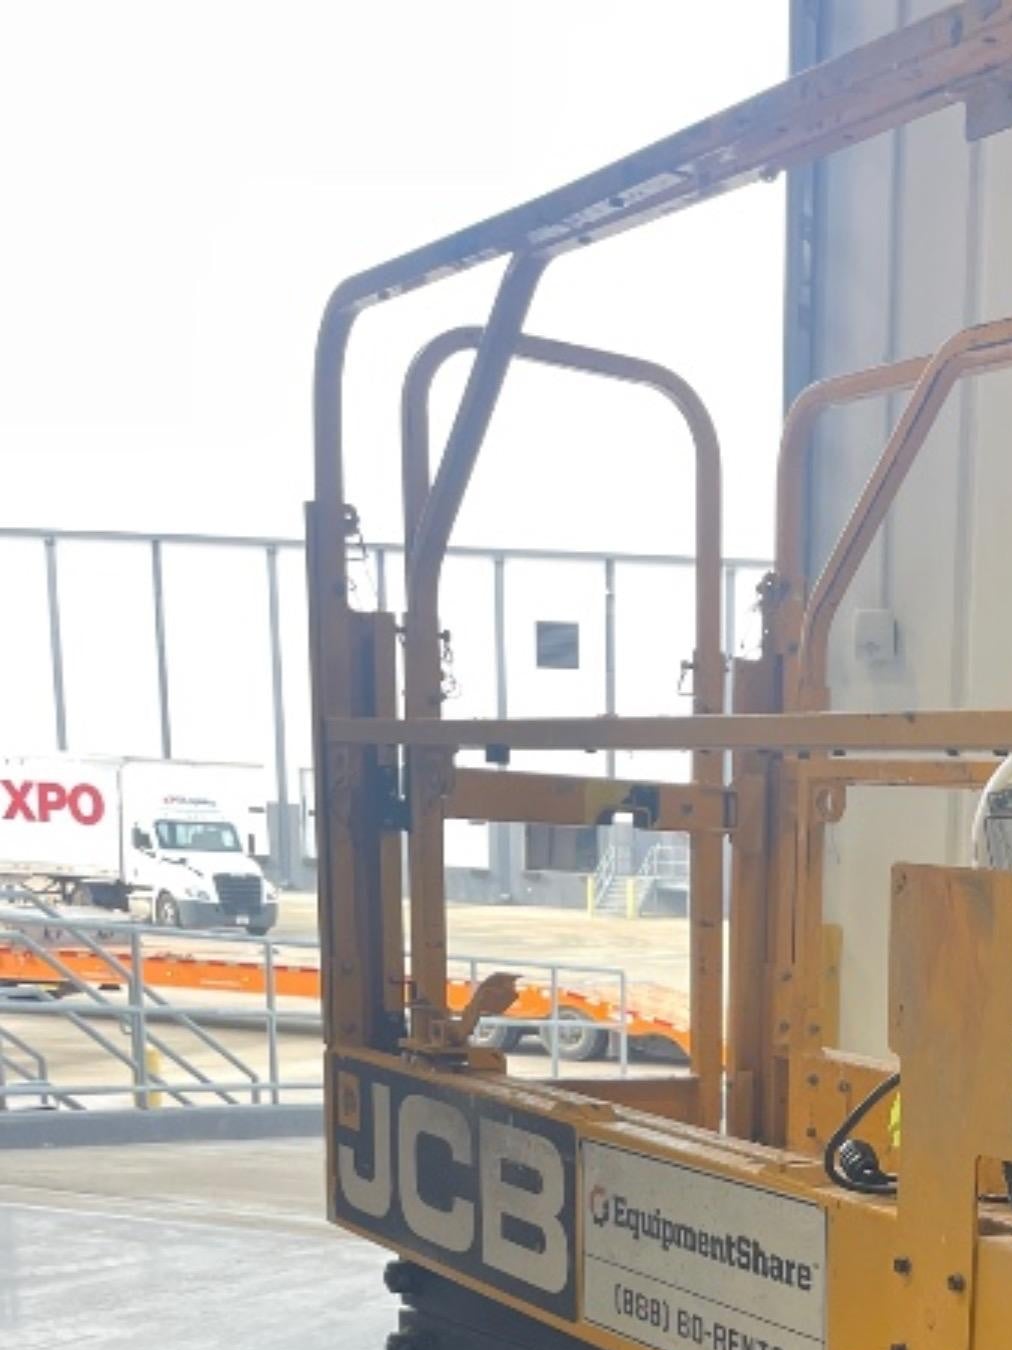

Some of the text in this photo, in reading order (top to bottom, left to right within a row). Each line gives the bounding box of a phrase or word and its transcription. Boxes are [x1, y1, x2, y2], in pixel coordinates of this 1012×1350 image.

[0, 779, 105, 826] XPO
[338, 1082, 568, 1294] JCB
[612, 1195, 812, 1291] EquipmentShare
